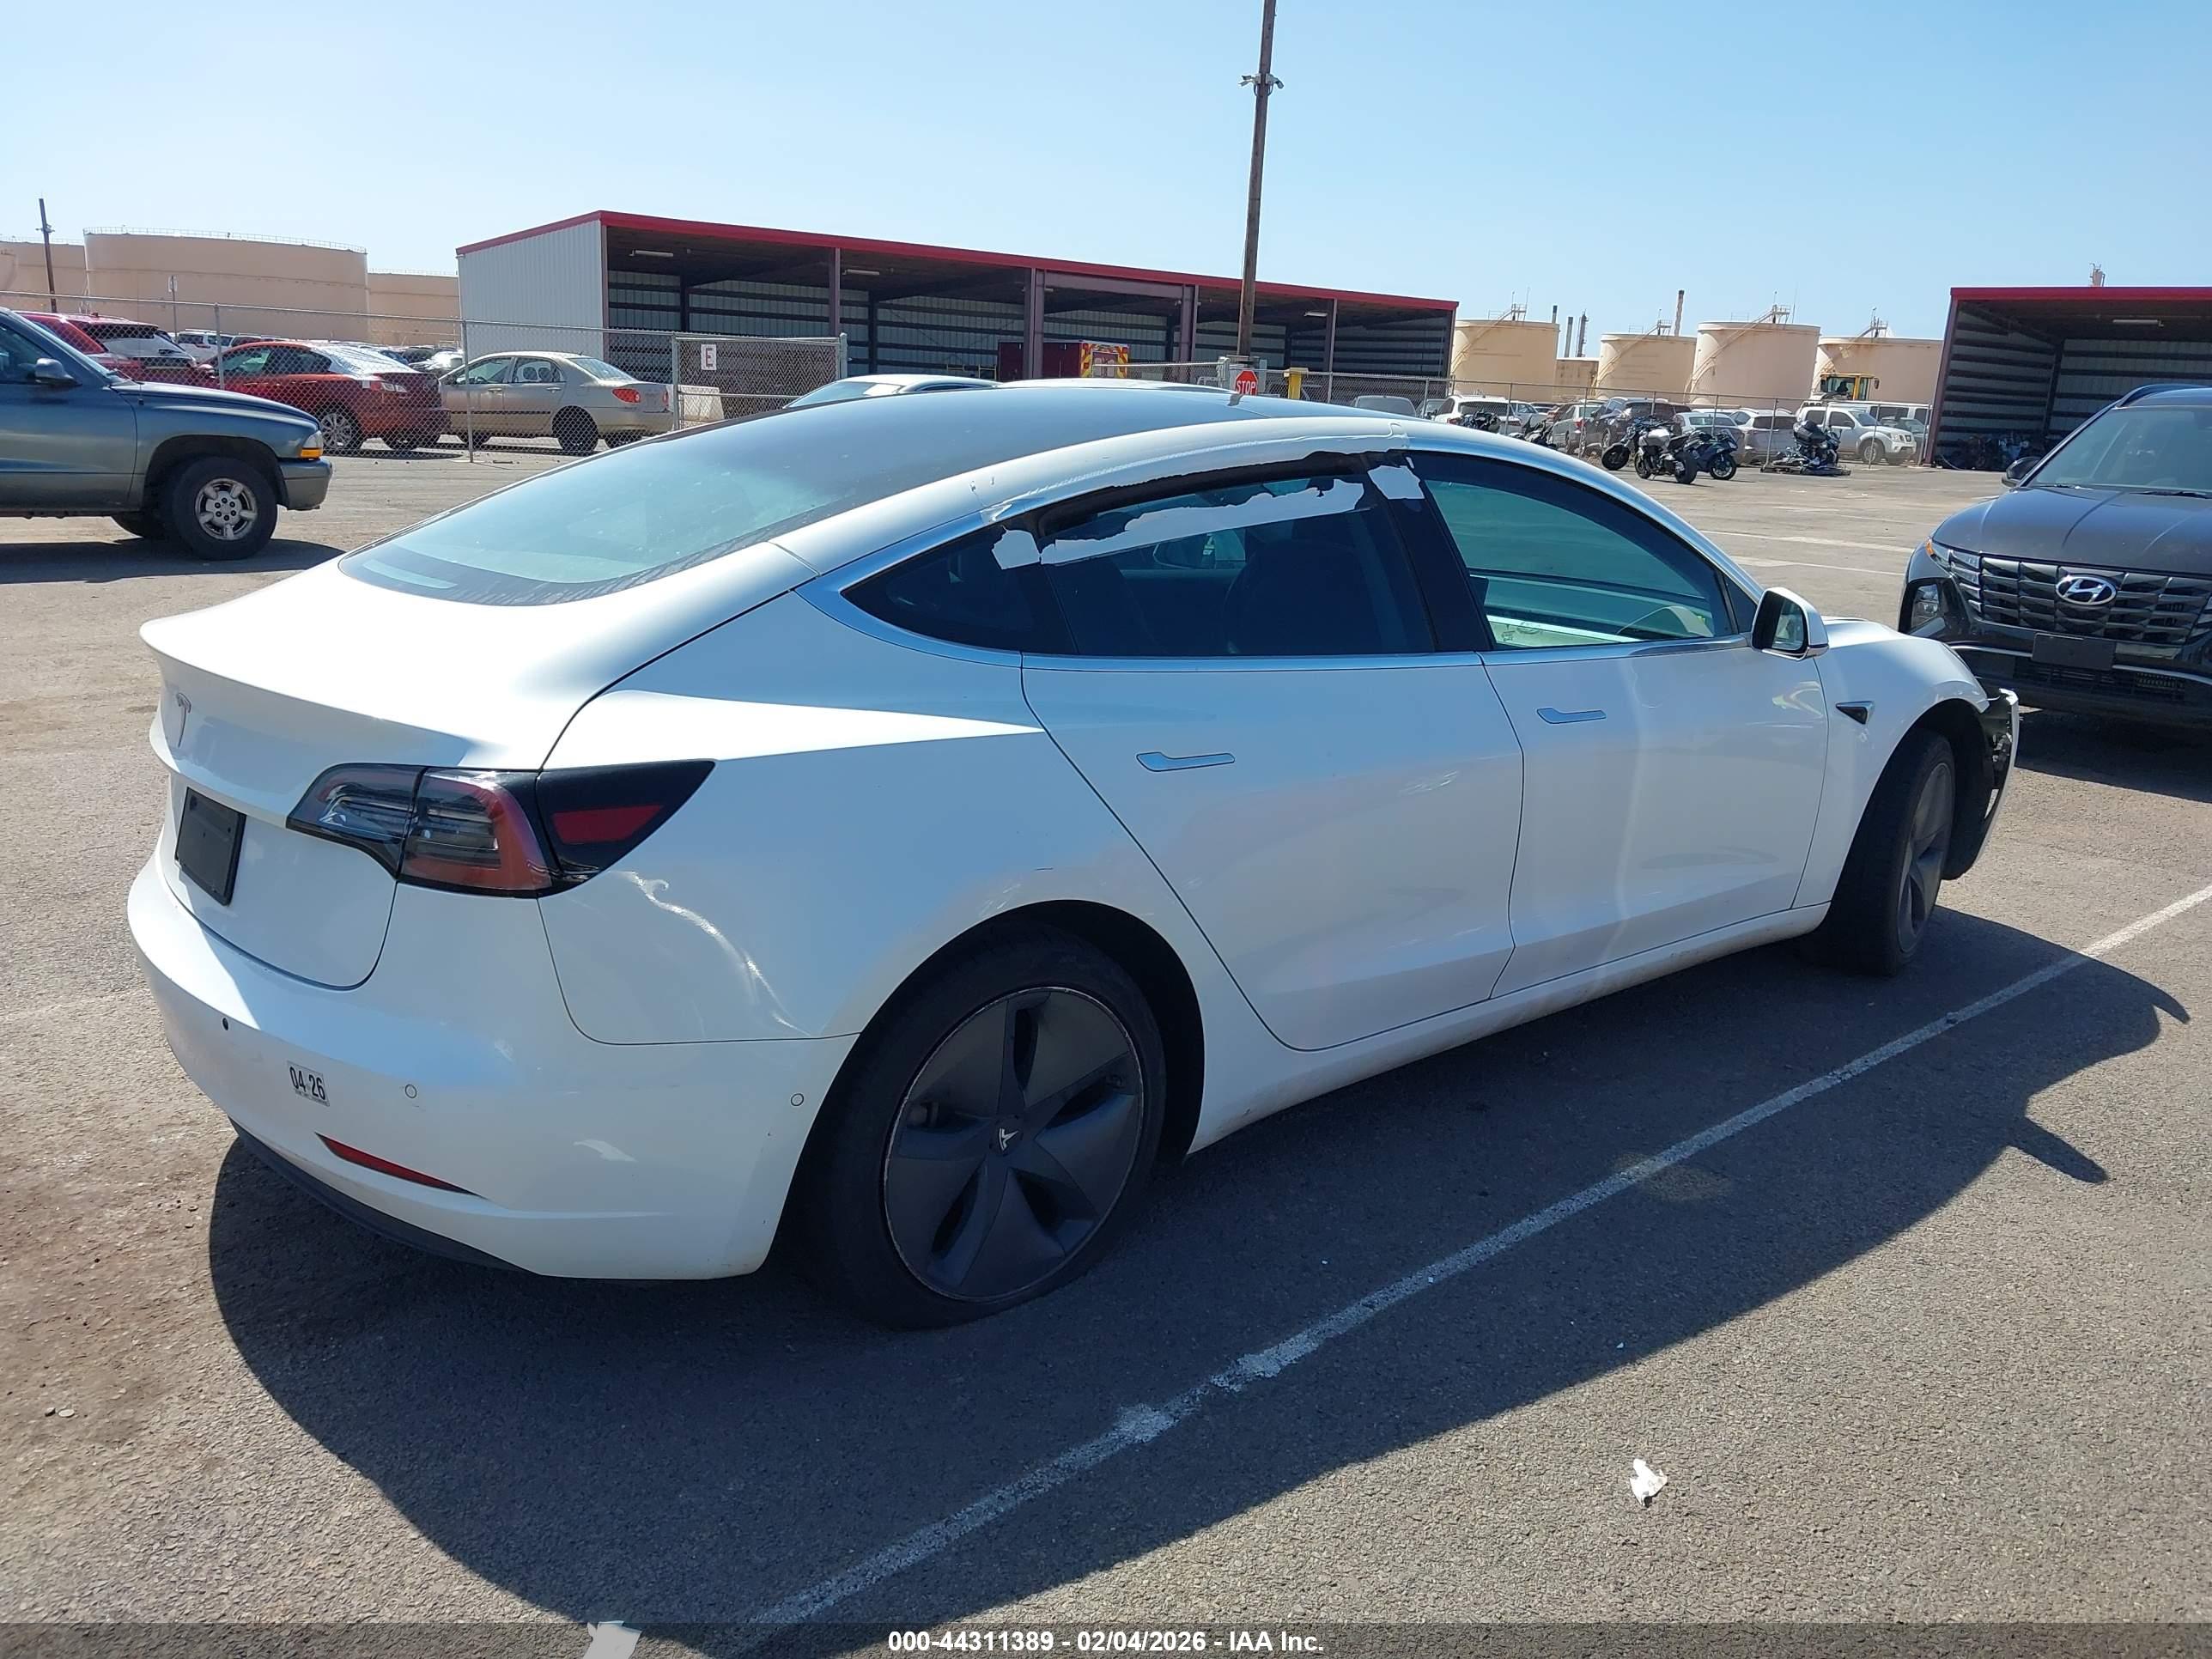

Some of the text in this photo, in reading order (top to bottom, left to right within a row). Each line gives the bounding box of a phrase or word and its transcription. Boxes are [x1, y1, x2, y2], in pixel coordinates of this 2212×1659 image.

[705, 347, 714, 368] E
[1237, 380, 1257, 395] STOP
[289, 1066, 307, 1093] 04
[308, 1073, 326, 1101] 26
